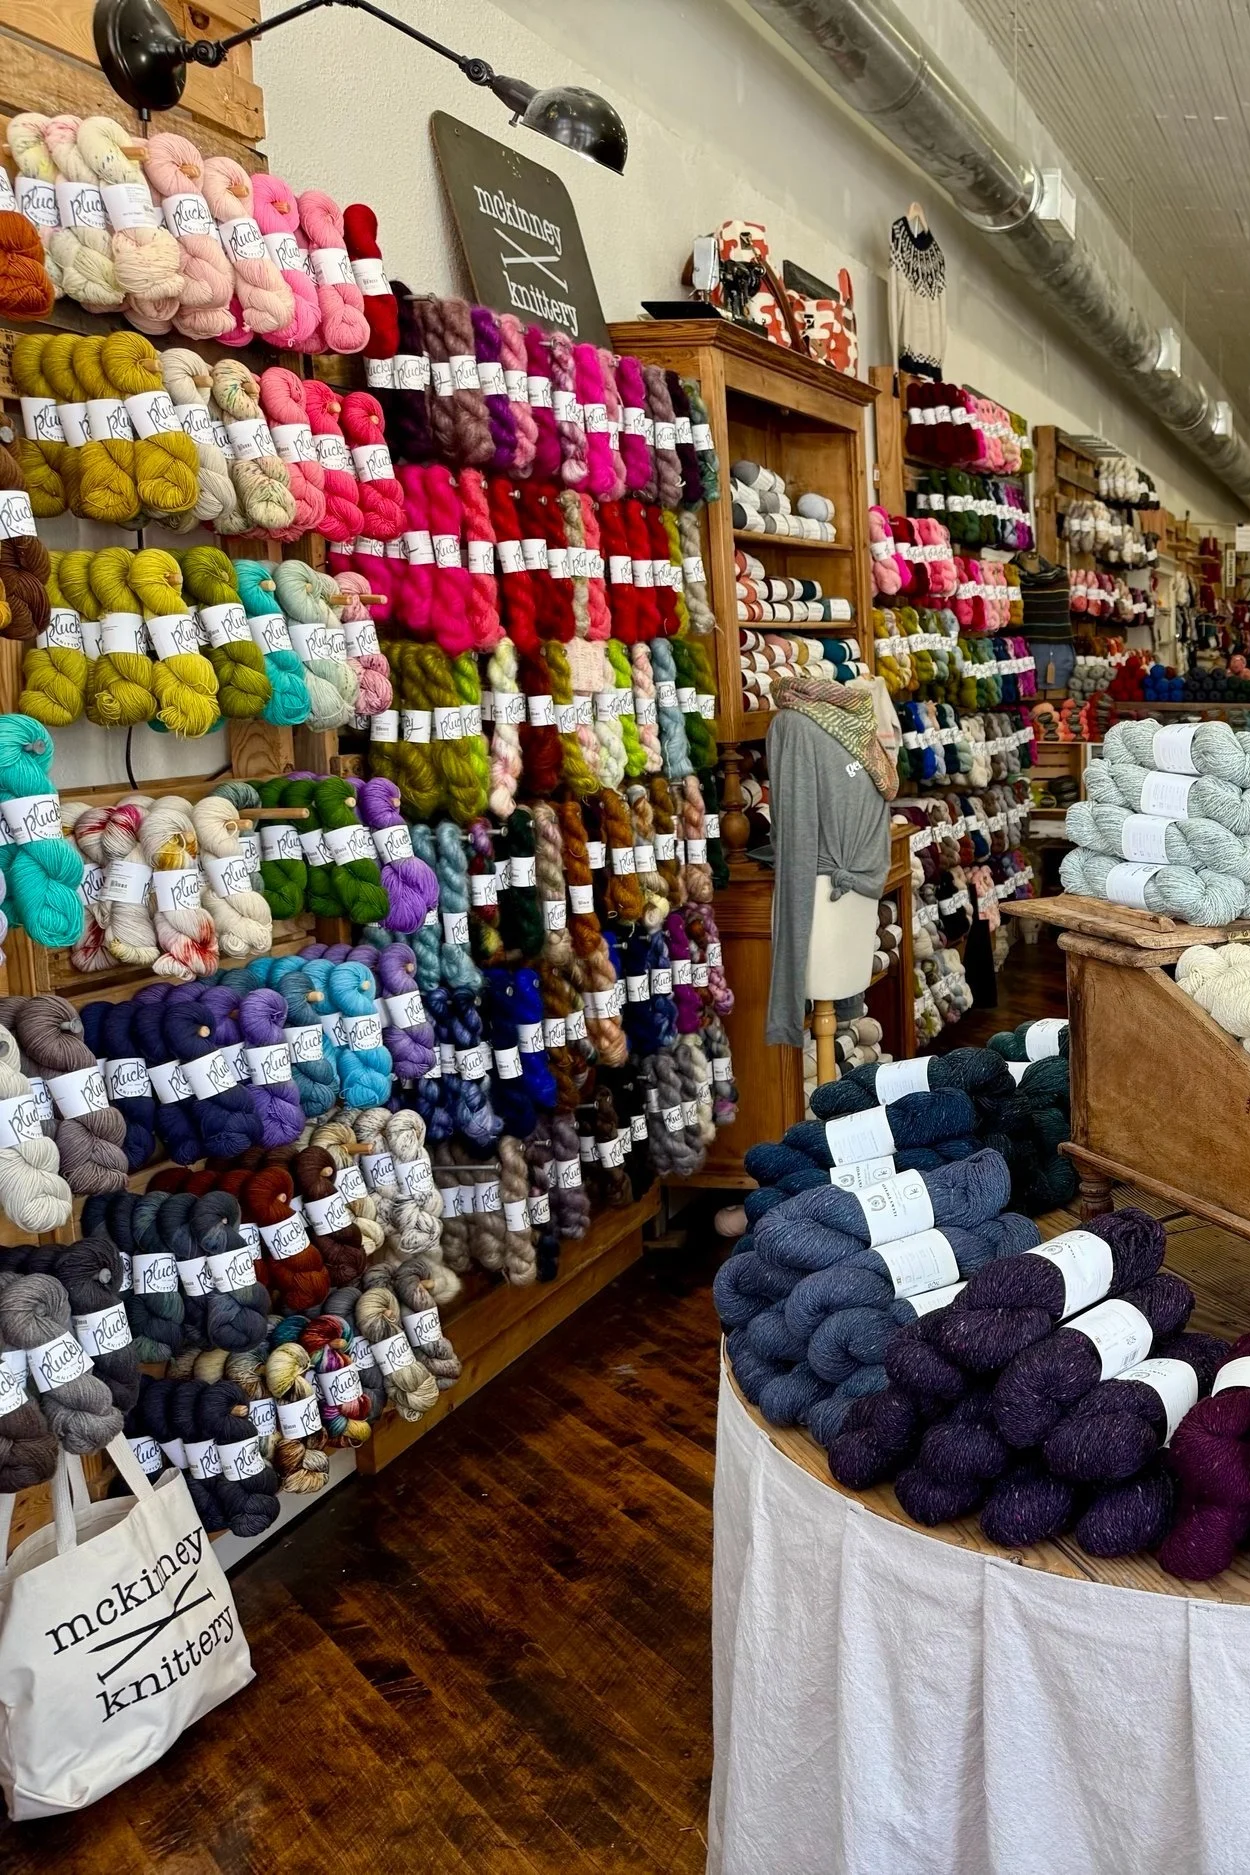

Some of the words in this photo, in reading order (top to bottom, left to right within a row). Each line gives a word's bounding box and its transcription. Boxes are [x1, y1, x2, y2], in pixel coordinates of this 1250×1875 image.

[473, 185, 562, 256] mckinney
[503, 270, 578, 337] knittery
[110, 1061, 150, 1100] plucky
[39, 1340, 84, 1390] plucky
[96, 1606, 236, 1722] knittery
